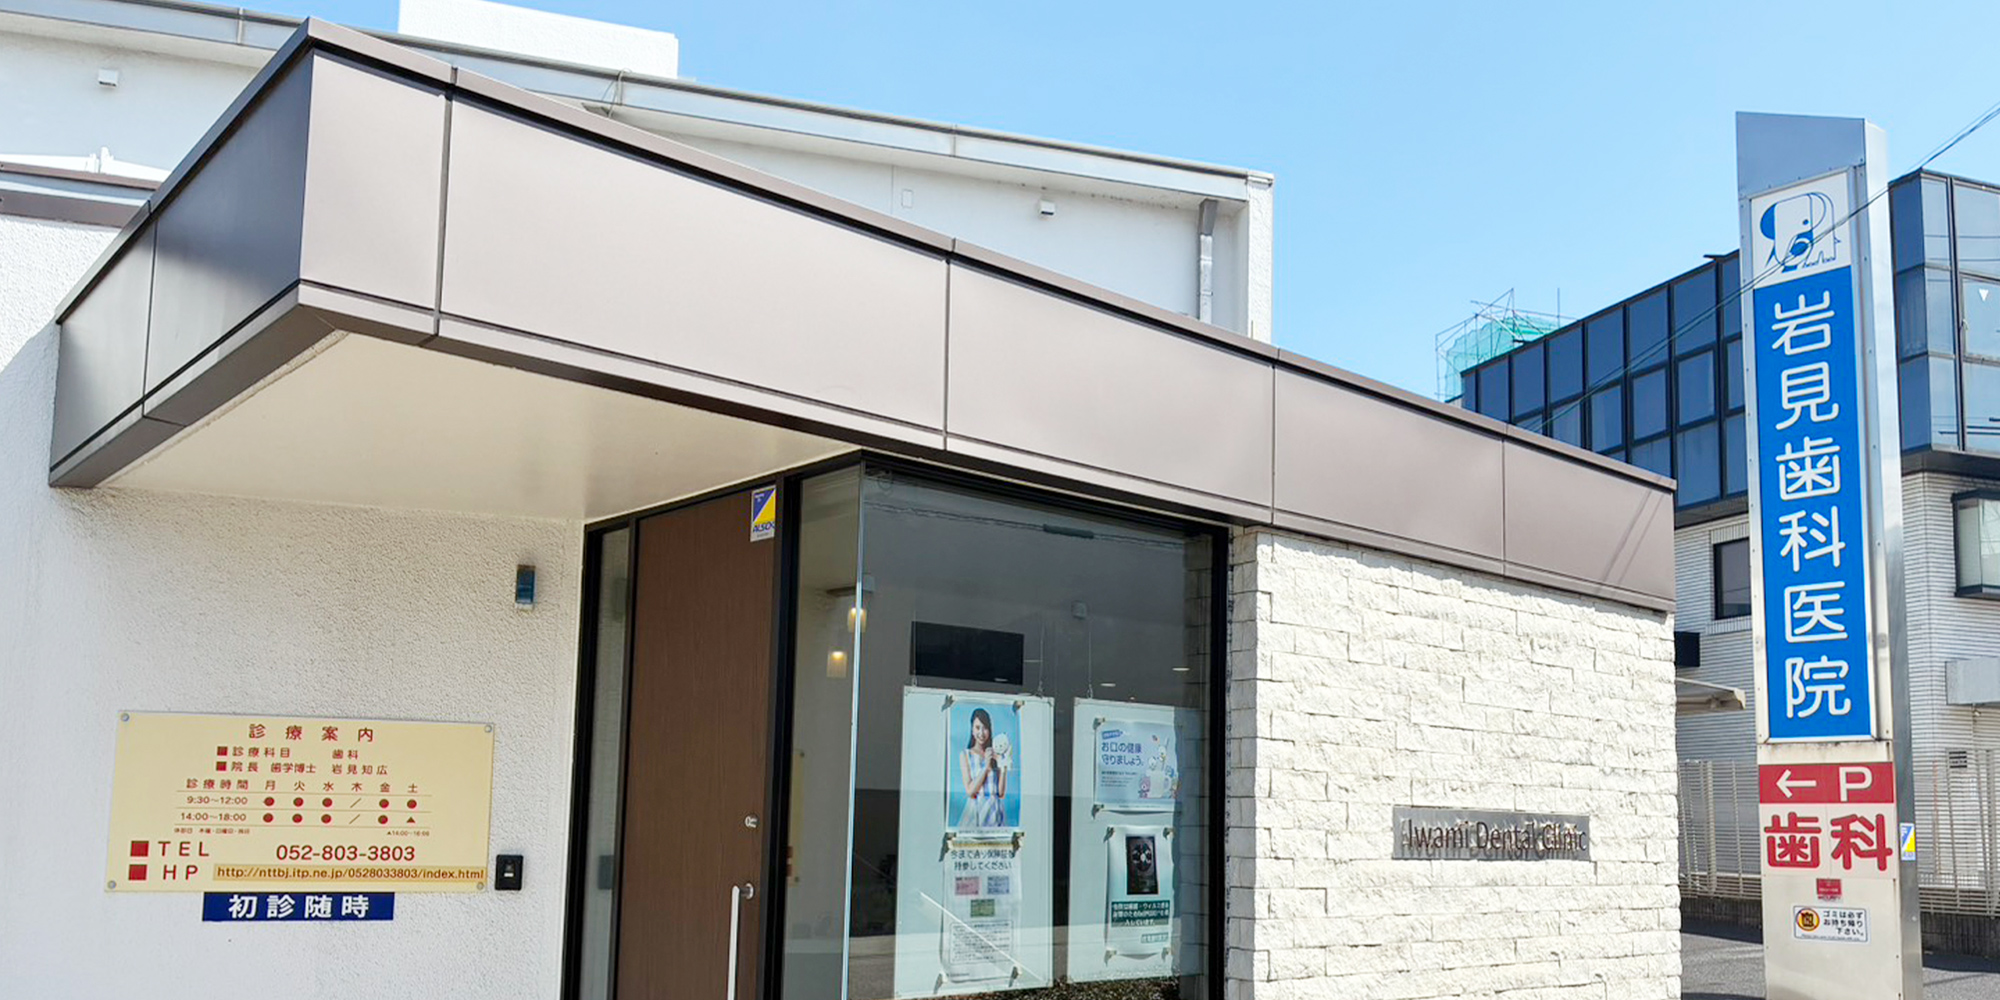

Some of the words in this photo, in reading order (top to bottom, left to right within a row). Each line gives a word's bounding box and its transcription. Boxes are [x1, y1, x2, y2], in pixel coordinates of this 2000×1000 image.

[1771, 290, 1852, 719] 岩見歯科医院
[249, 723, 373, 742] 診療案内
[232, 746, 290, 758] 診療科目
[332, 749, 359, 760] 歯科
[231, 761, 259, 773] 院長
[271, 762, 316, 774] 歯学博士
[332, 764, 388, 775] 岩見知広
[186, 778, 249, 790] 診療時間
[265, 780, 276, 790] 月
[294, 781, 305, 791] 火
[323, 781, 334, 792] 水
[351, 782, 362, 792] 木
[380, 782, 391, 793] 金
[407, 783, 418, 793] 土
[1838, 766, 1873, 802] P
[1407, 819, 1470, 850] Iwami
[1475, 821, 1537, 850] Dental
[1540, 823, 1586, 852] Clinic
[1764, 812, 1893, 871] 歯科
[158, 841, 210, 857] TEL
[276, 844, 415, 861] 052-803-3803
[163, 864, 198, 880] HP
[217, 866, 484, 880] http://nttbj.itp.ne.jp/0528033803/index.html
[228, 894, 369, 919] 初診随時
